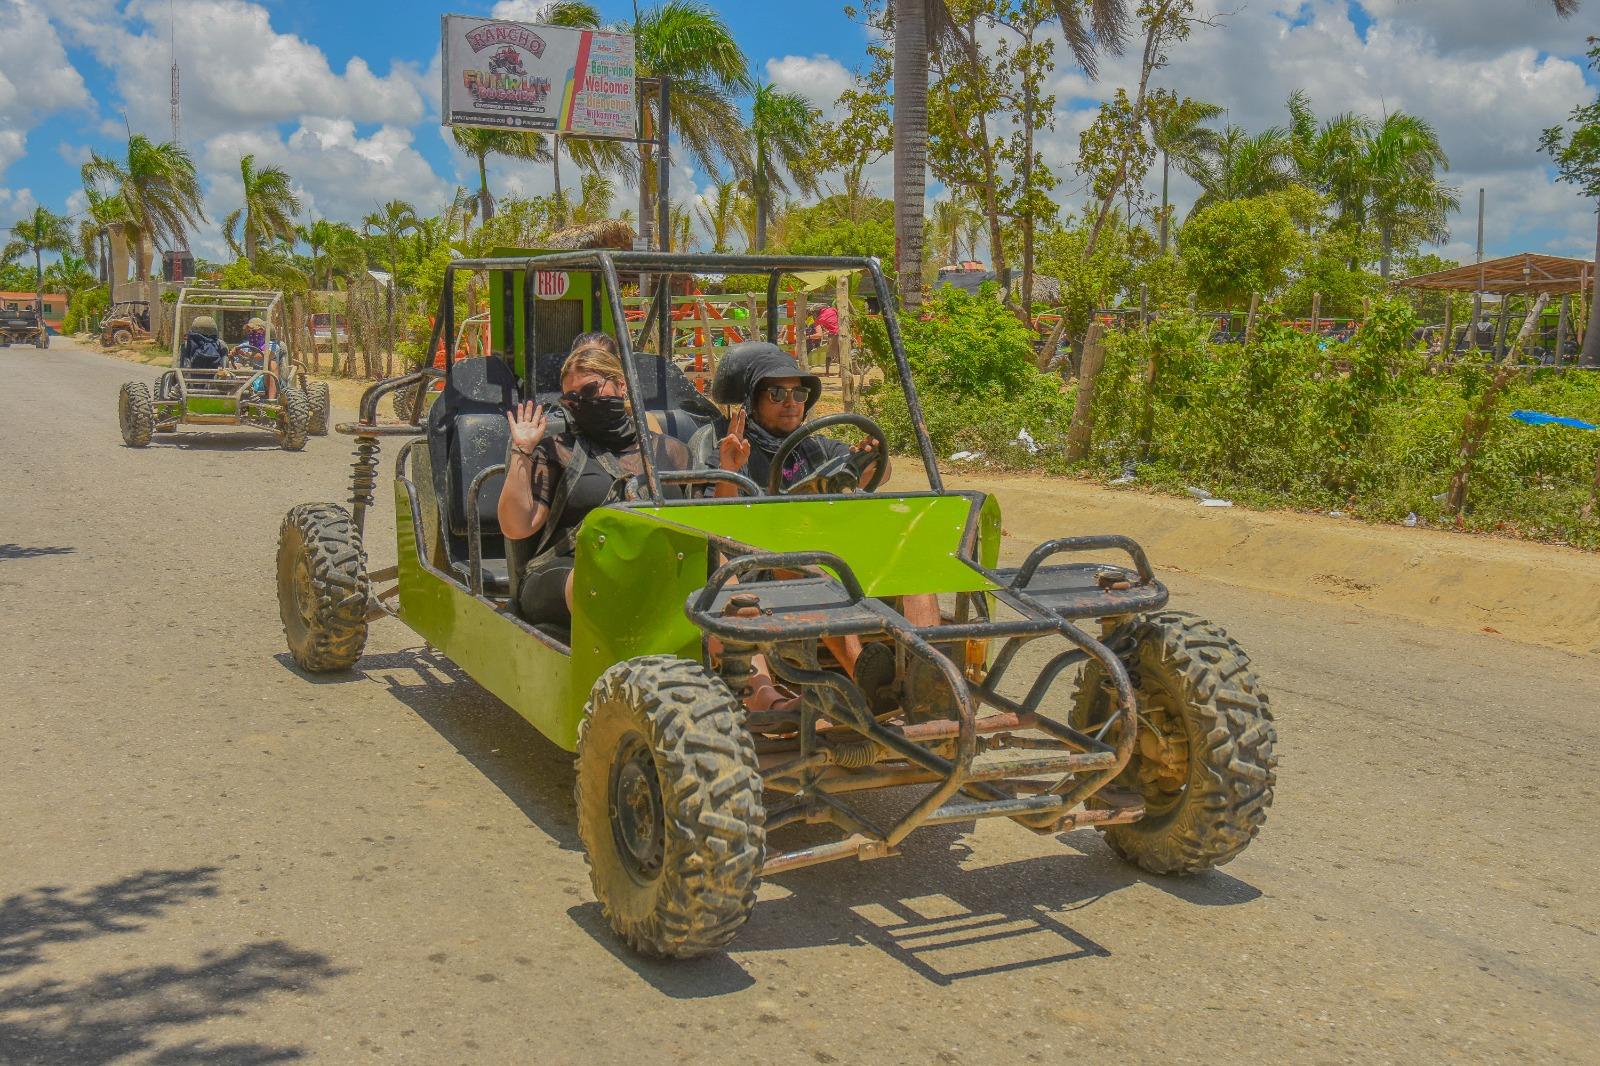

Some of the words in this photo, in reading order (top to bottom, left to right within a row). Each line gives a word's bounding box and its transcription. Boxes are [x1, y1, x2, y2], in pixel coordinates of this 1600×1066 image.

[472, 27, 541, 51] RANCHO
[591, 61, 633, 77] Bem-vindo
[585, 76, 629, 94] Welcome
[586, 95, 631, 111] Bienvenue
[537, 271, 565, 295] FR16
